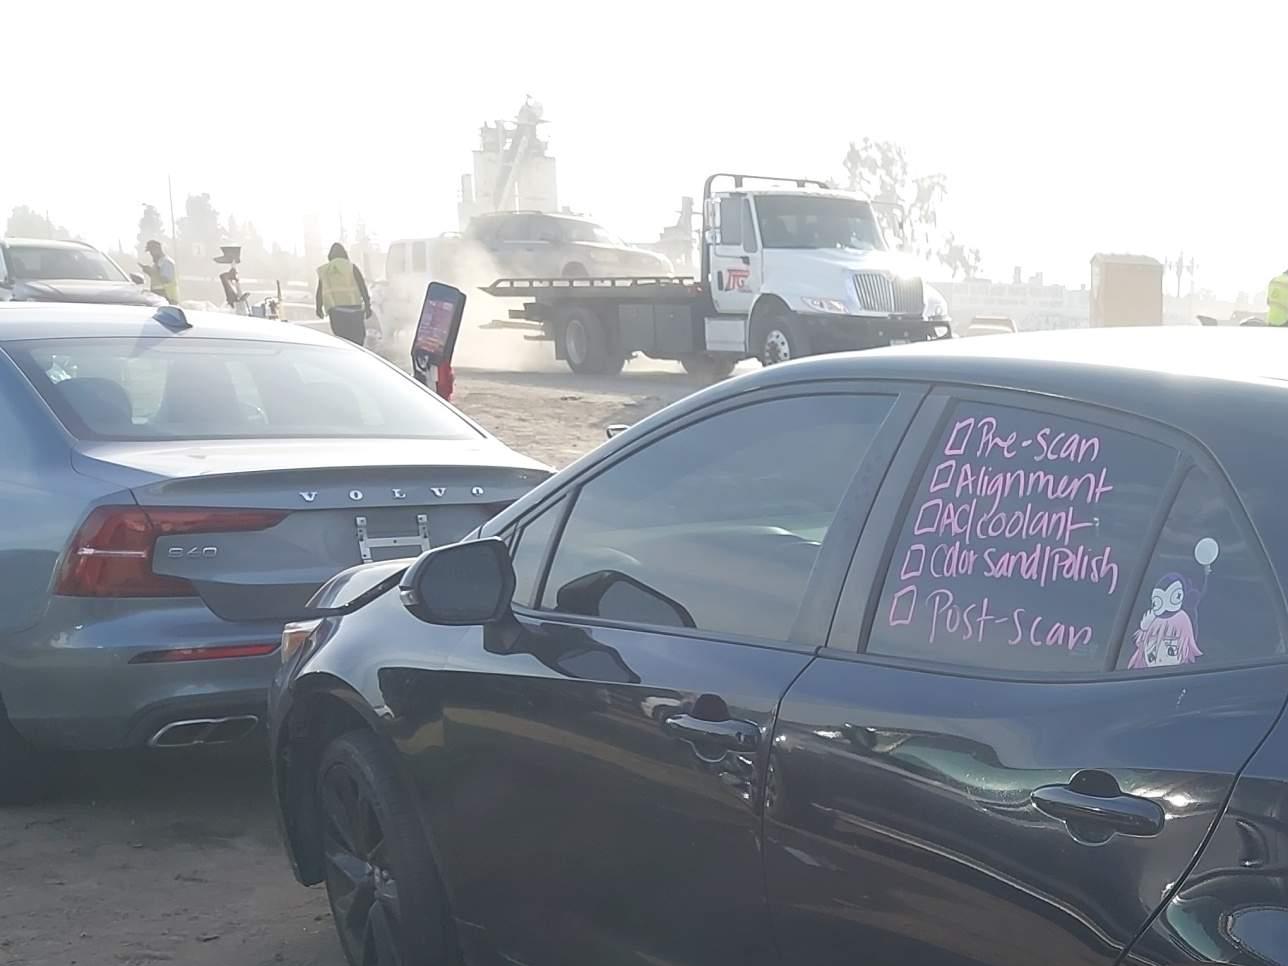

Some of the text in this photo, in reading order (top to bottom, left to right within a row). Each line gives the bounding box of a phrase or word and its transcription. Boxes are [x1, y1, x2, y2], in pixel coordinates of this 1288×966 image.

[300, 486, 485, 502] VOLVO
[955, 462, 1113, 512] Alignment
[167, 546, 218, 559] S60
[930, 541, 979, 578] Color
